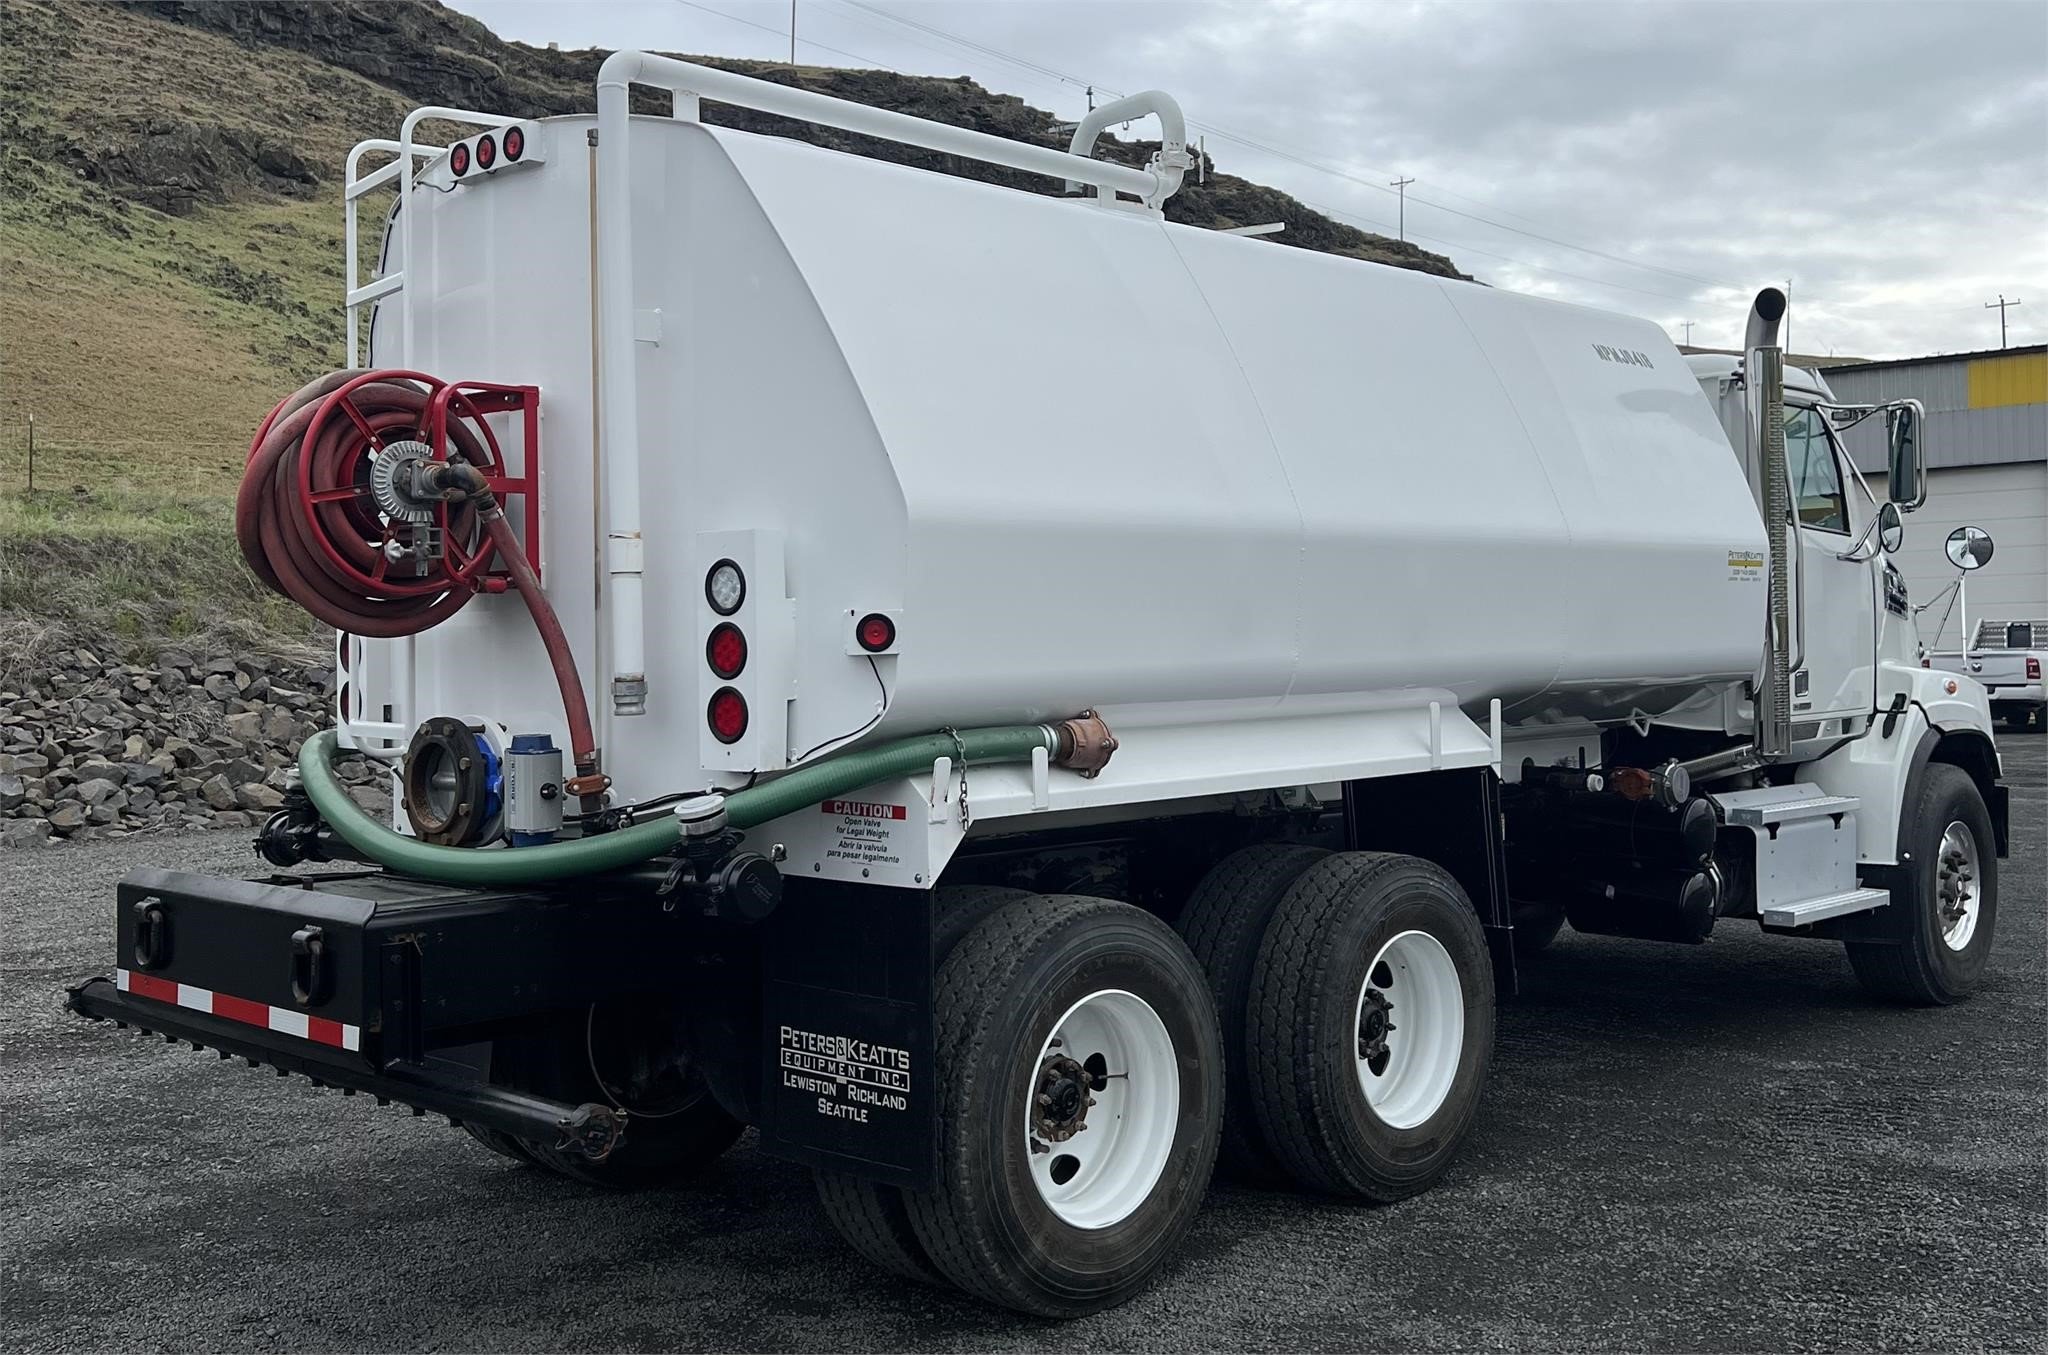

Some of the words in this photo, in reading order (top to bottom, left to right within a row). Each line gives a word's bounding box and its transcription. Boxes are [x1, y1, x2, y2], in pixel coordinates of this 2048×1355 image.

[834, 801, 893, 818] CAUTION
[844, 816, 862, 826] Open
[863, 818, 881, 828] Valve
[836, 825, 846, 834] for
[846, 826, 865, 838] Legal
[866, 829, 890, 840] Weight
[838, 840, 855, 850] Abrir
[856, 842, 863, 851] la
[827, 849, 841, 858] para
[862, 852, 900, 864] legalmente
[784, 1051, 866, 1080] EQUIPMENT
[874, 1069, 906, 1088] INC.
[783, 1070, 837, 1097] LEWISTON
[847, 1084, 907, 1111] RICHLAND
[817, 1097, 869, 1124] SEATTLE
